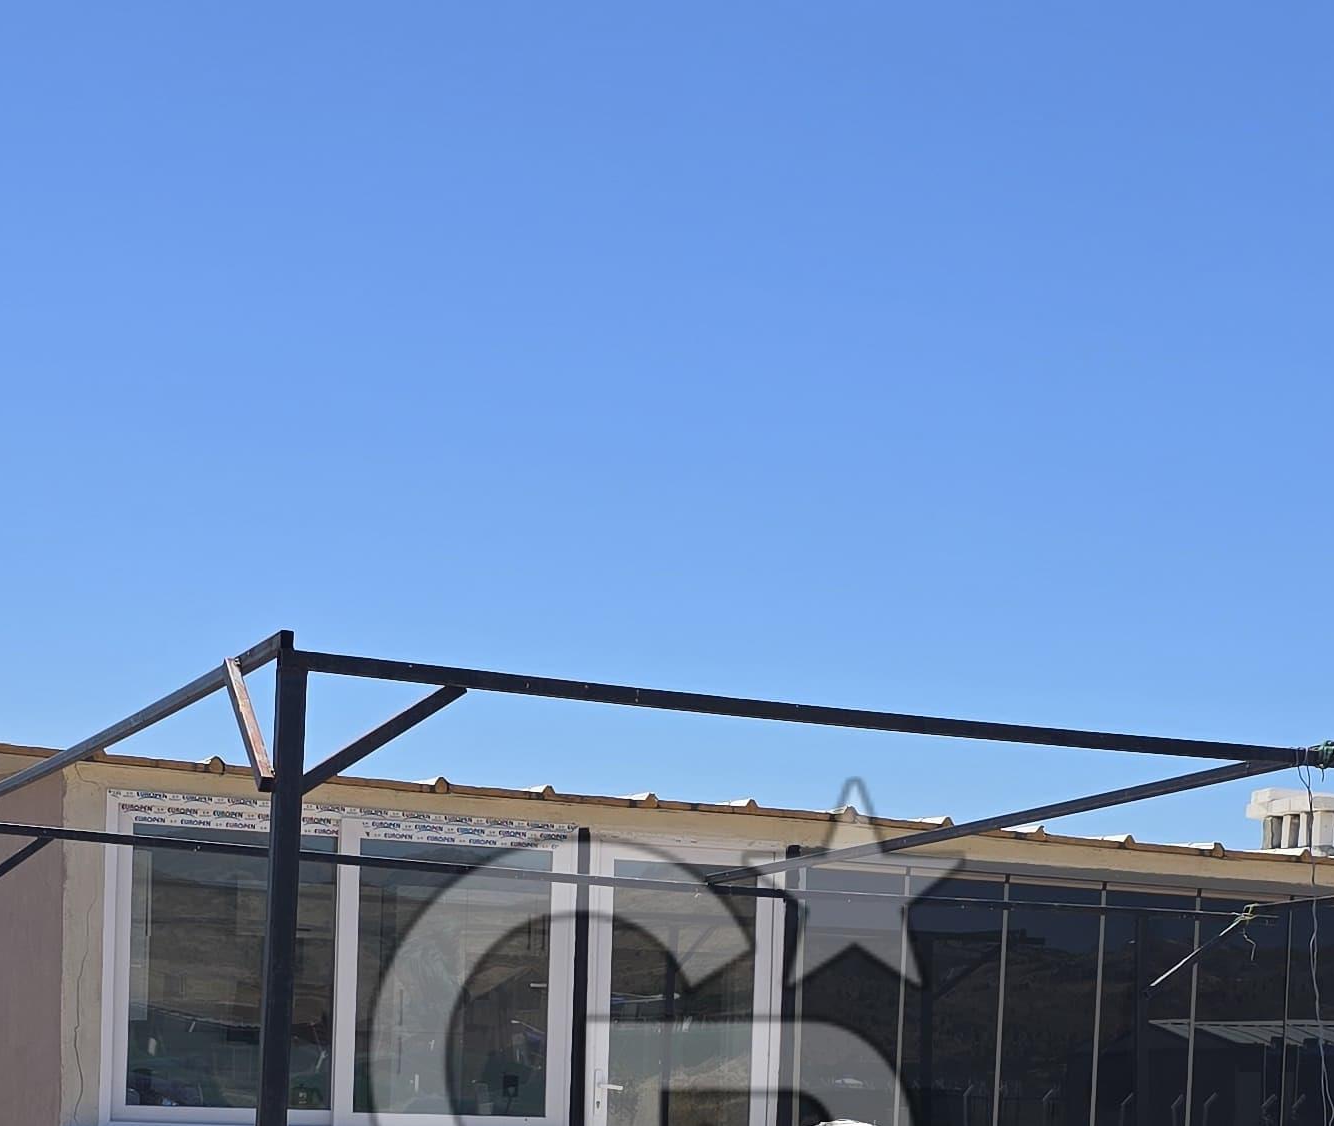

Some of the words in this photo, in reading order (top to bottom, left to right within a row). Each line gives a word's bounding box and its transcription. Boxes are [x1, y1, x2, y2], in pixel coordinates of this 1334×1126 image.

[121, 803, 153, 812] EUROPEN
[167, 806, 199, 815] EUROPEN
[213, 809, 243, 818] EUROPEN
[134, 815, 166, 824] EUROPEN
[180, 818, 211, 827] EUROPEN
[225, 822, 256, 830] EUROPEN
[302, 816, 332, 825] EUROPEN
[314, 828, 339, 836] EUROPE
[371, 821, 401, 829] EUROPEN
[414, 824, 444, 832] EUROPEN
[456, 826, 485, 835] EUROPEN
[498, 829, 527, 838] EUROPEN
[539, 832, 568, 840] EUROPEN
[383, 832, 413, 840] EUROPEN
[426, 835, 456, 843] EUROPEN
[468, 838, 497, 846] EUROPEN
[510, 841, 539, 849] EUROPEN
